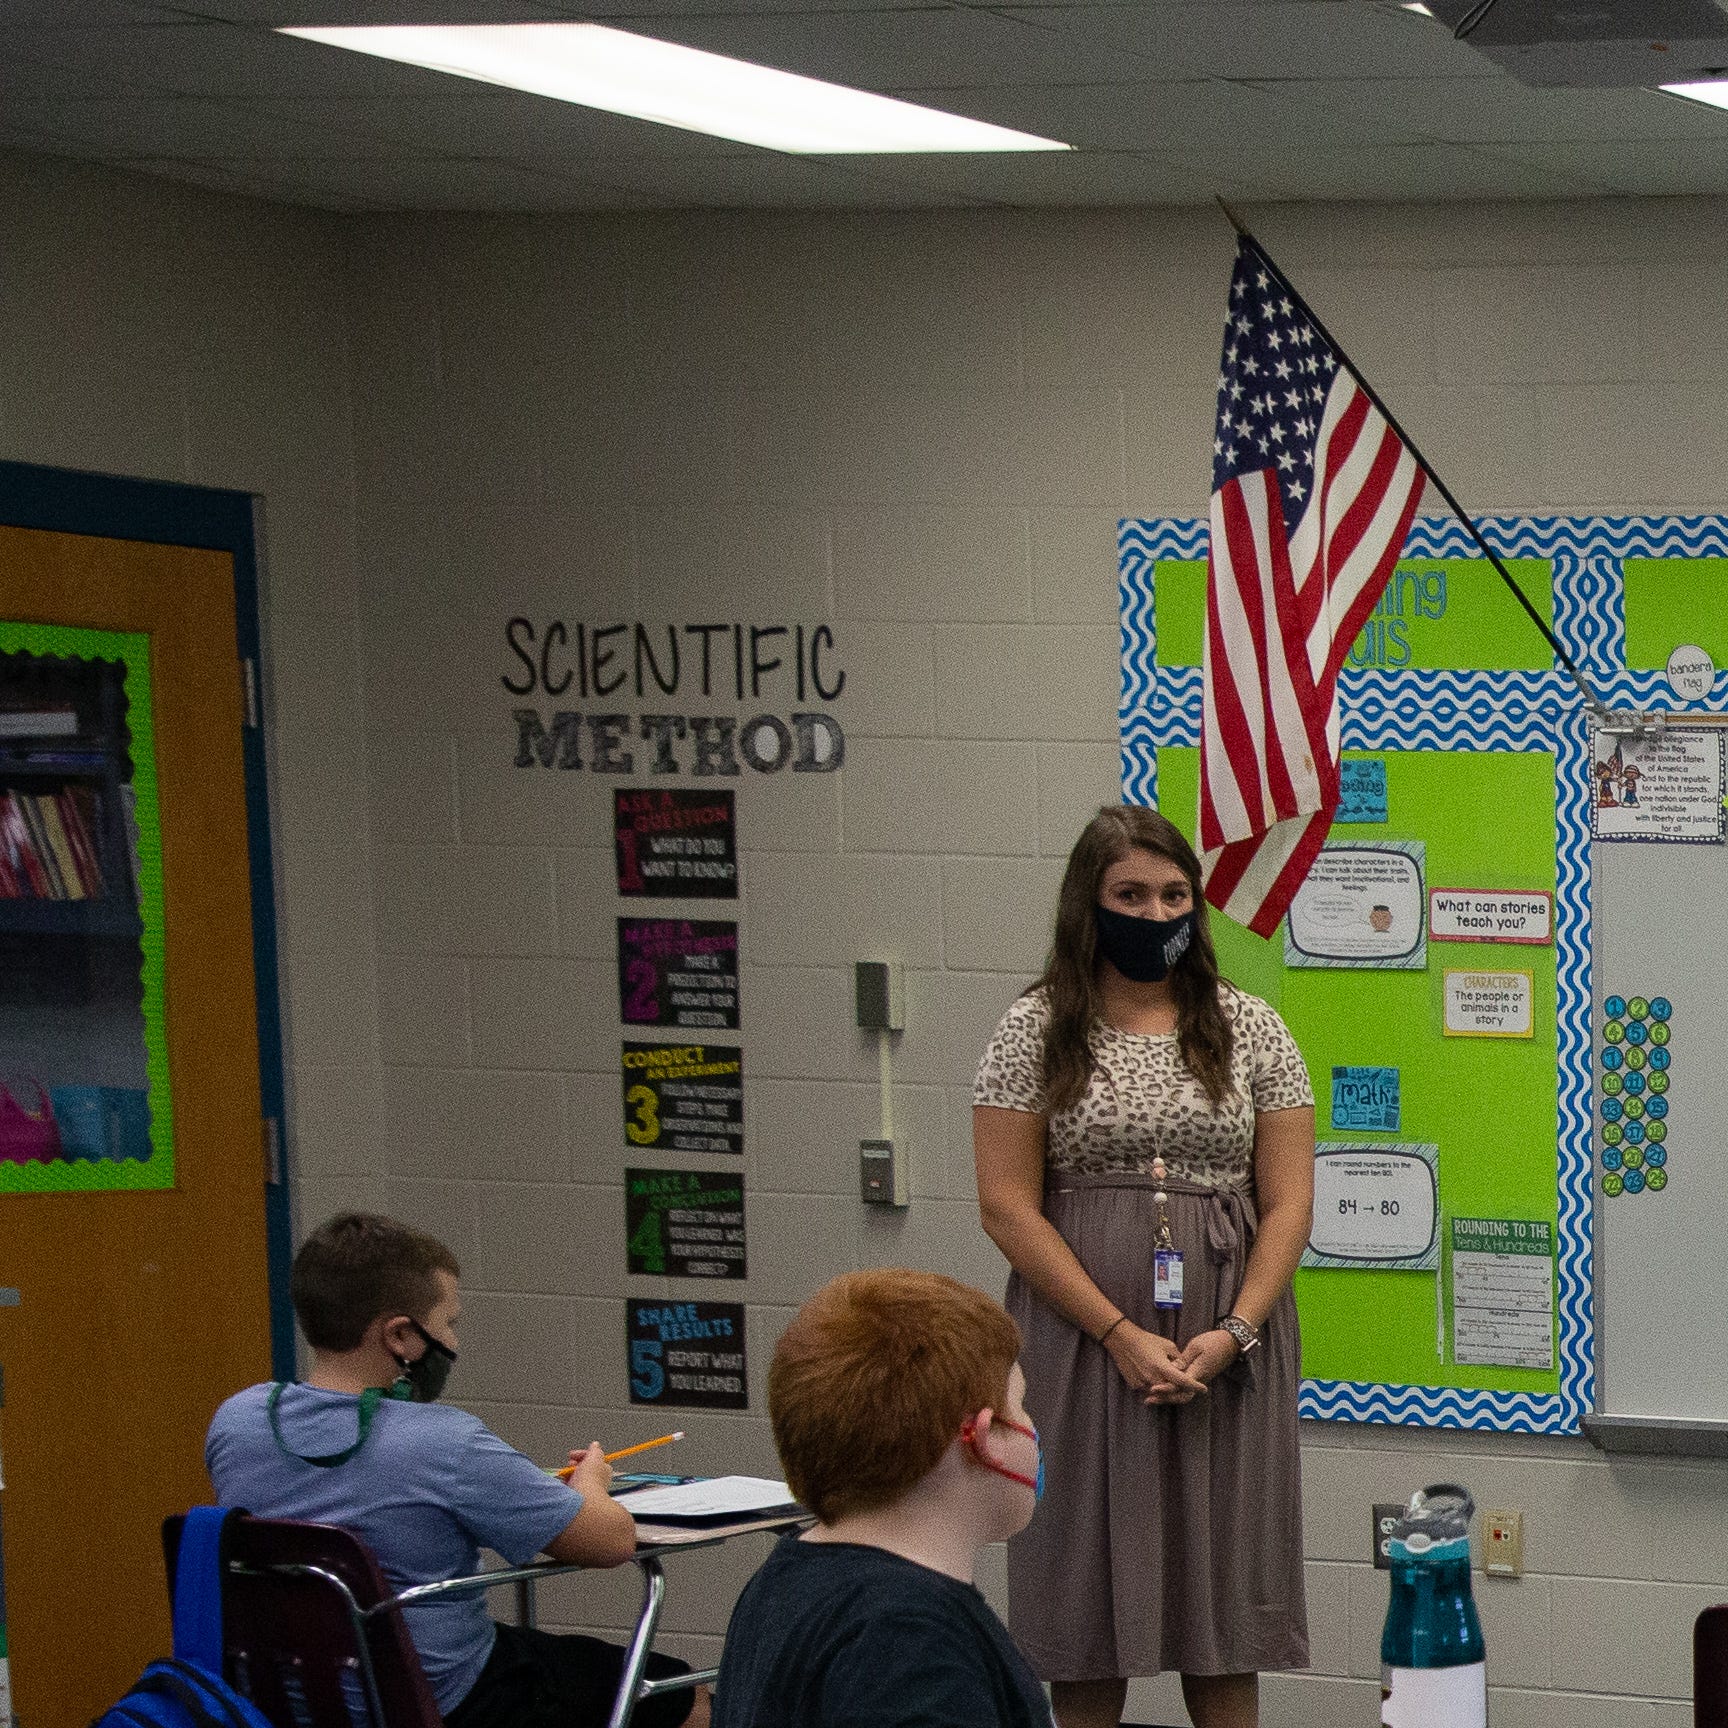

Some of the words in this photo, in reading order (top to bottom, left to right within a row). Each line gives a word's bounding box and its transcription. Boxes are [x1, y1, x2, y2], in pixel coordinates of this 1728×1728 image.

[502, 616, 847, 702] SCIENTIFIC
[1669, 662, 1712, 676] bandera
[511, 709, 847, 777] METHOD
[1436, 899, 1472, 912] What
[1475, 902, 1497, 914] can
[1500, 902, 1546, 915] stories
[1456, 916, 1493, 929] teach
[1497, 917, 1526, 931] you?
[1463, 975, 1519, 990] CHARACTERS
[1455, 990, 1473, 1001] The
[1475, 991, 1510, 1003] people
[1512, 992, 1524, 1001] or
[1461, 1003, 1499, 1013] animals
[1501, 1003, 1510, 1013] in
[1511, 1004, 1519, 1013] a
[1475, 1014, 1505, 1027] story
[622, 1047, 704, 1069] CONDUCT
[1340, 1081, 1389, 1107] math
[626, 1085, 660, 1144] 3
[1338, 1199, 1358, 1215] 84
[1380, 1200, 1400, 1216] 80
[1454, 1219, 1509, 1237] ROUNDING
[1513, 1221, 1529, 1237] TO
[1530, 1222, 1550, 1238] THE
[636, 1304, 698, 1326] SHARE
[659, 1318, 734, 1340] RESULTS
[630, 1339, 666, 1398] 5
